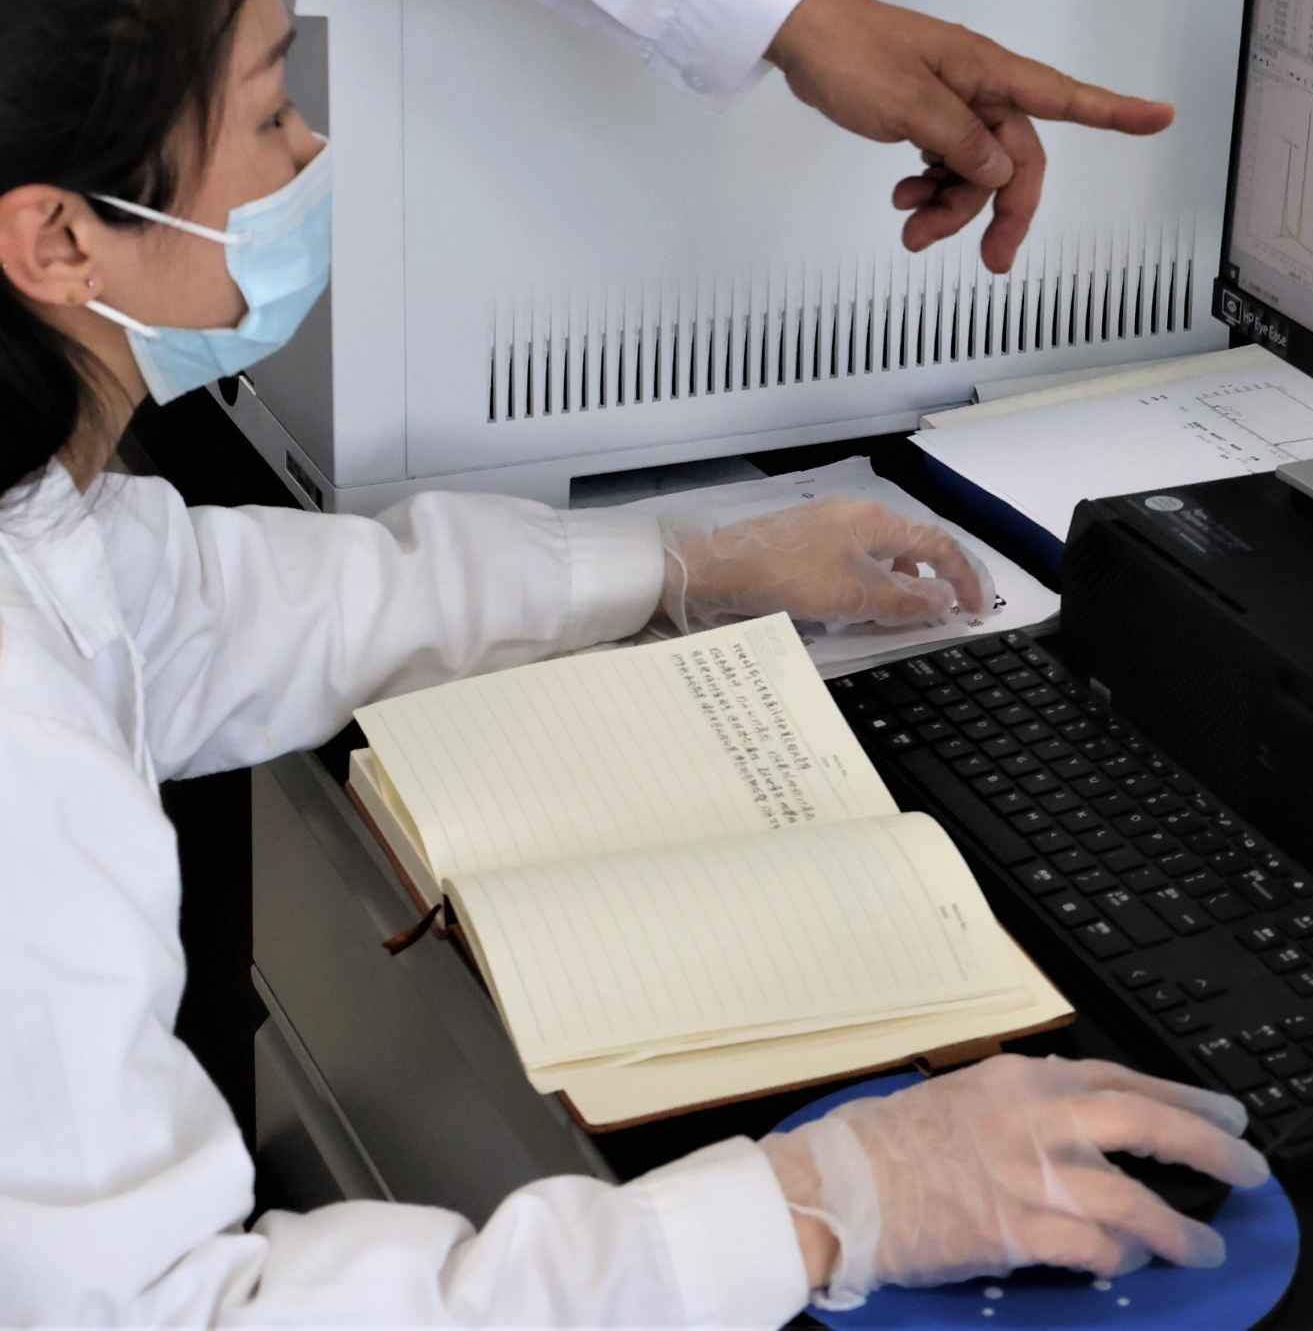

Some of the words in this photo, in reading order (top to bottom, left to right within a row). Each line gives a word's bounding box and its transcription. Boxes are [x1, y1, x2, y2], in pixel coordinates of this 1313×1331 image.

[1243, 310, 1254, 324] HP
[1254, 317, 1268, 335] Eye
[1269, 325, 1287, 346] Ease
